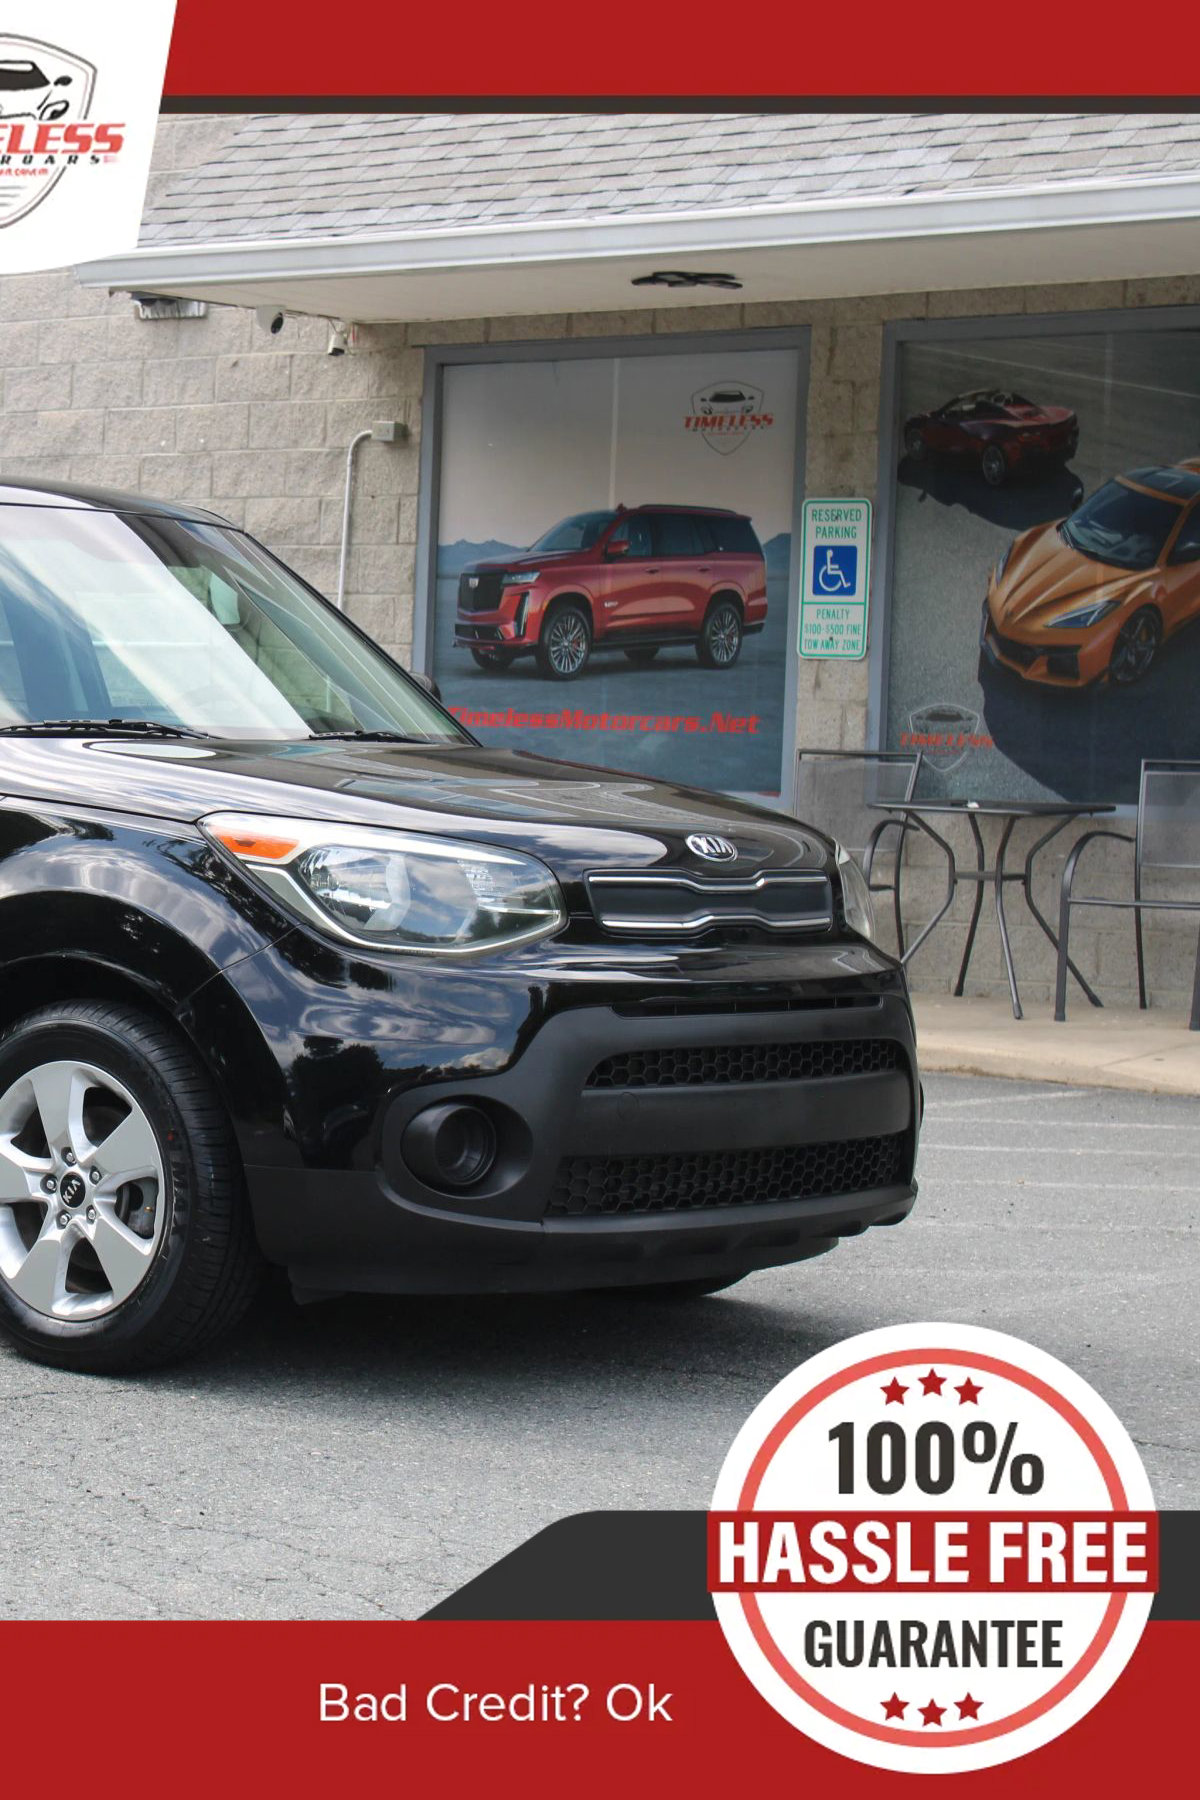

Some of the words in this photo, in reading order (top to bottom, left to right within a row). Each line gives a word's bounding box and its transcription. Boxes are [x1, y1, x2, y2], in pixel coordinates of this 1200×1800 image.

[684, 413, 775, 429] TIMELESS
[811, 508, 862, 522] RESERVED
[815, 526, 858, 539] PARKING
[816, 608, 850, 620] PENALTY
[846, 624, 862, 636] FINE
[804, 638, 818, 650] TOW
[820, 639, 840, 650] AWAY
[842, 639, 861, 650] ZONE
[692, 836, 734, 854] KIA
[62, 1179, 81, 1204] KIA
